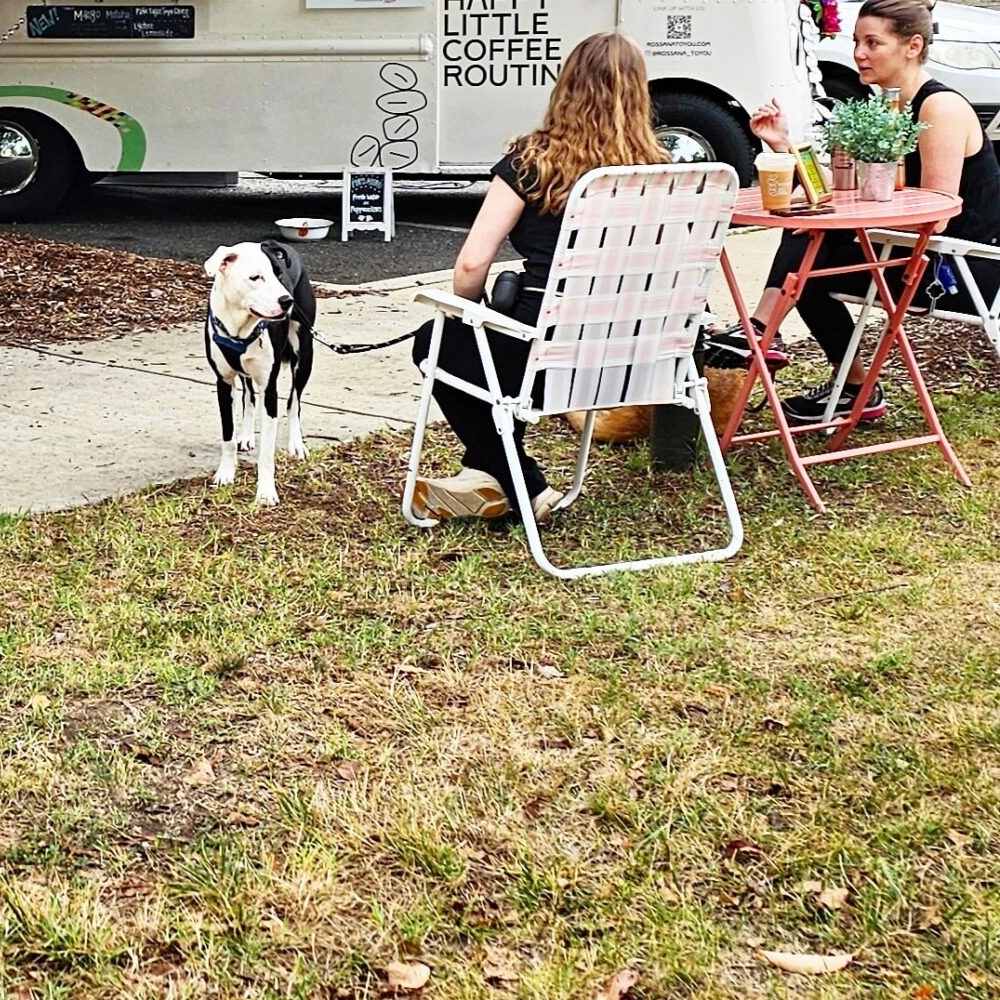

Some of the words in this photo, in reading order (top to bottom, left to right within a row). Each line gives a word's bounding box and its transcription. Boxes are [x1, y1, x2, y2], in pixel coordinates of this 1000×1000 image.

[444, 12, 549, 37] LITTLE
[442, 38, 562, 62] COFFEE
[443, 63, 562, 87] ROUTIN
